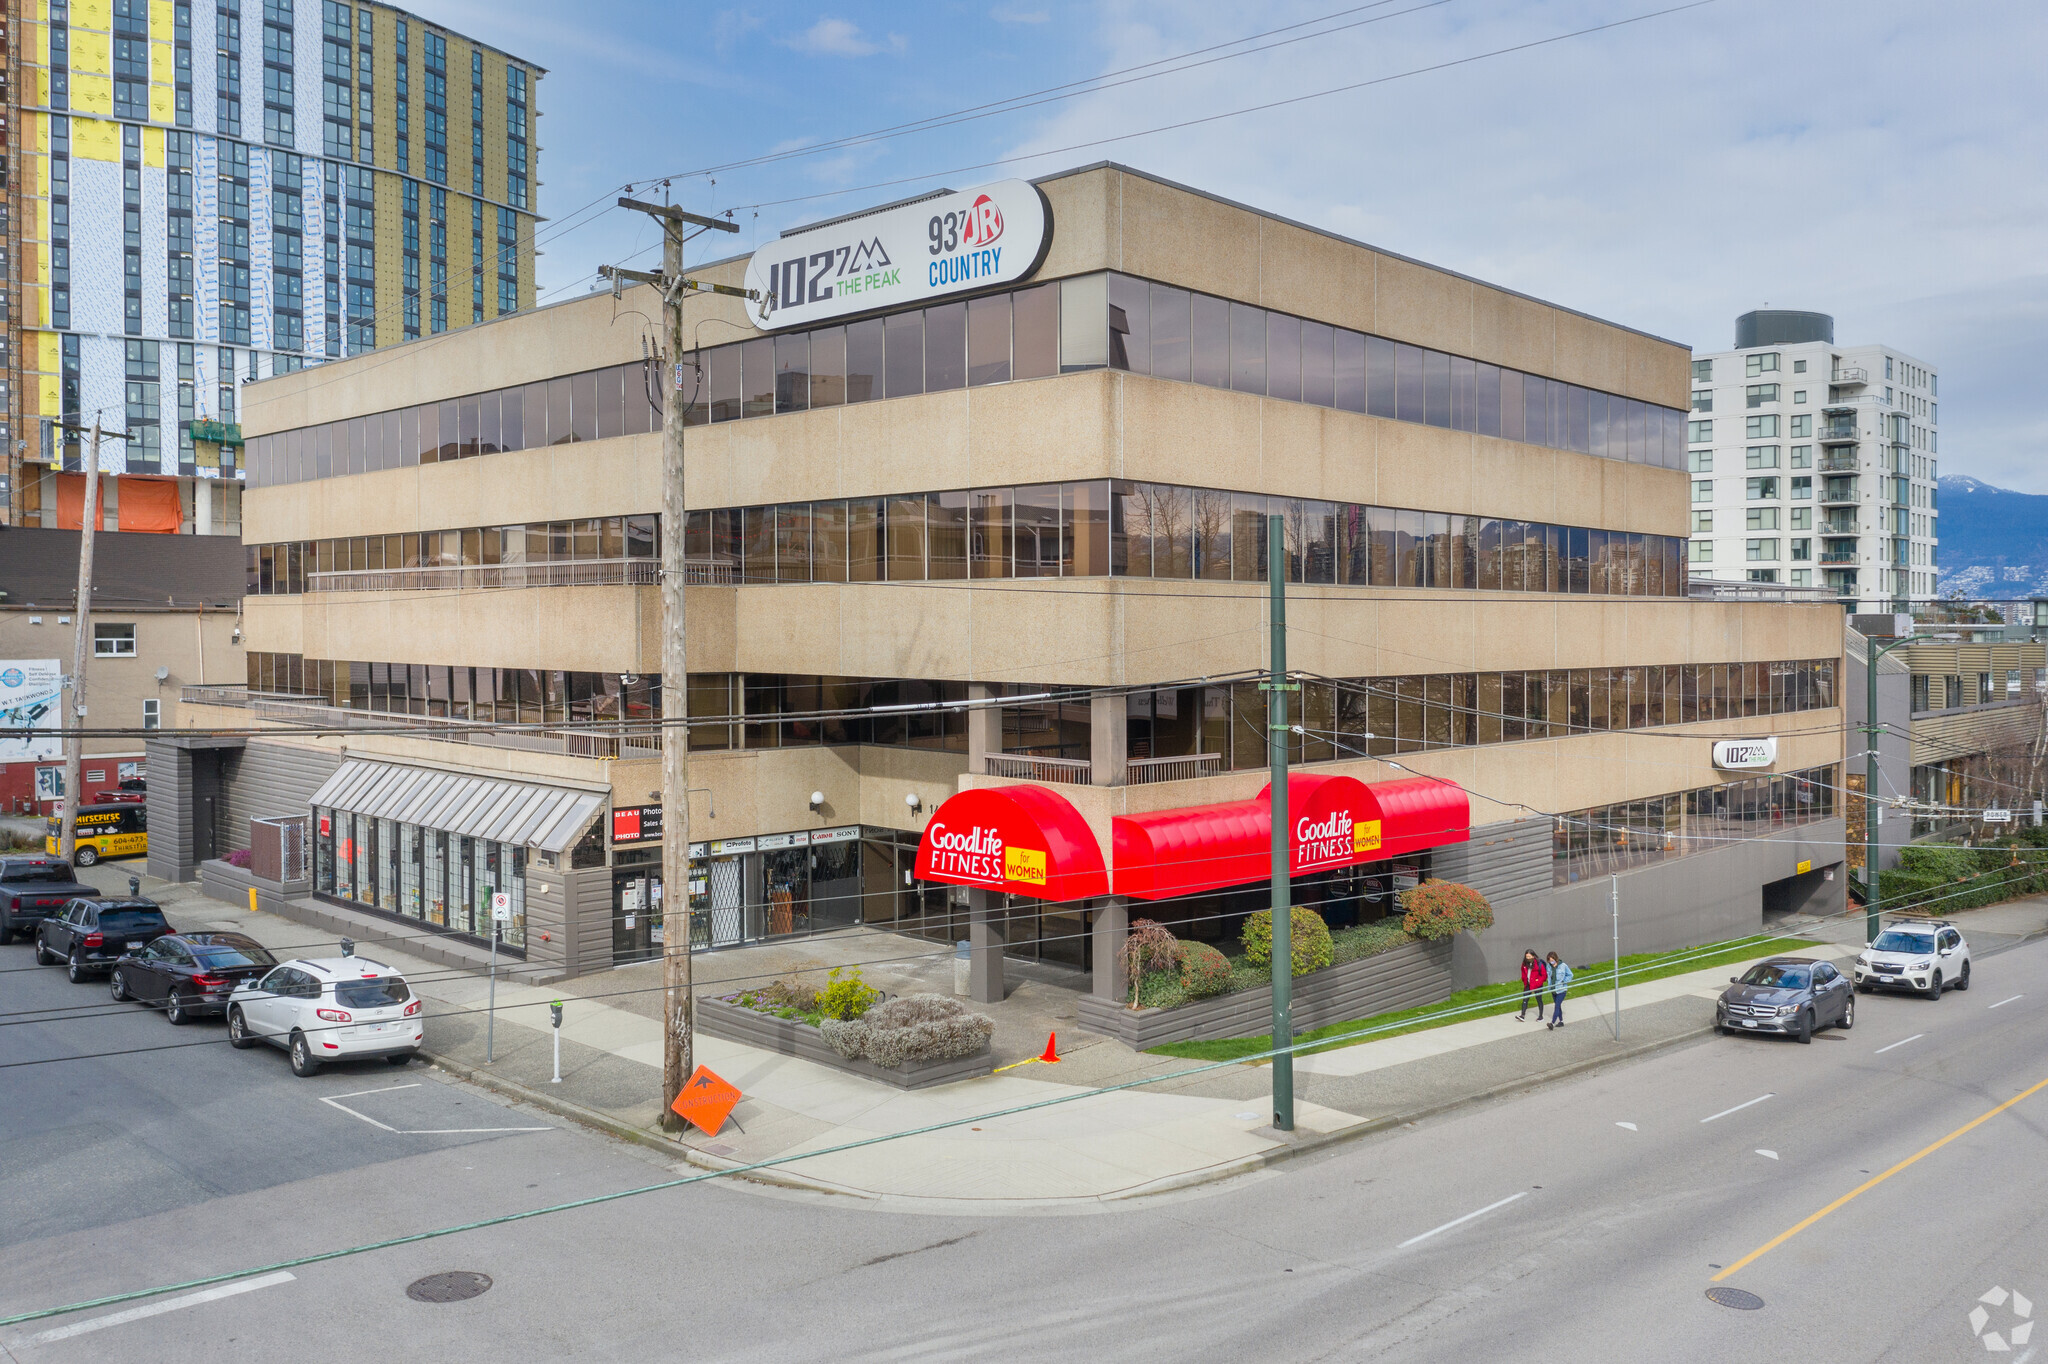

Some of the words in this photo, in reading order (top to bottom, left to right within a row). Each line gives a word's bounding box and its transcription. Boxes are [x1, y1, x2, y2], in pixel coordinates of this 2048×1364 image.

[928, 247, 1002, 288] COUNTRY
[836, 276, 862, 297] THE
[864, 267, 901, 292] PEAK
[615, 810, 640, 818] BEAU
[643, 820, 658, 828] Sales
[1297, 809, 1352, 842] GoodLife
[1363, 823, 1371, 836] for
[615, 832, 640, 840] PHOTO
[812, 832, 833, 840] Canon
[836, 829, 858, 837] SONY
[929, 822, 1002, 856] GoodLife
[1354, 835, 1380, 848] WOMEN
[1020, 851, 1030, 865] for
[1007, 863, 1044, 880] WOMEN
[36, 898, 71, 906] RA
[677, 1091, 736, 1110] CONSTRUCTION
